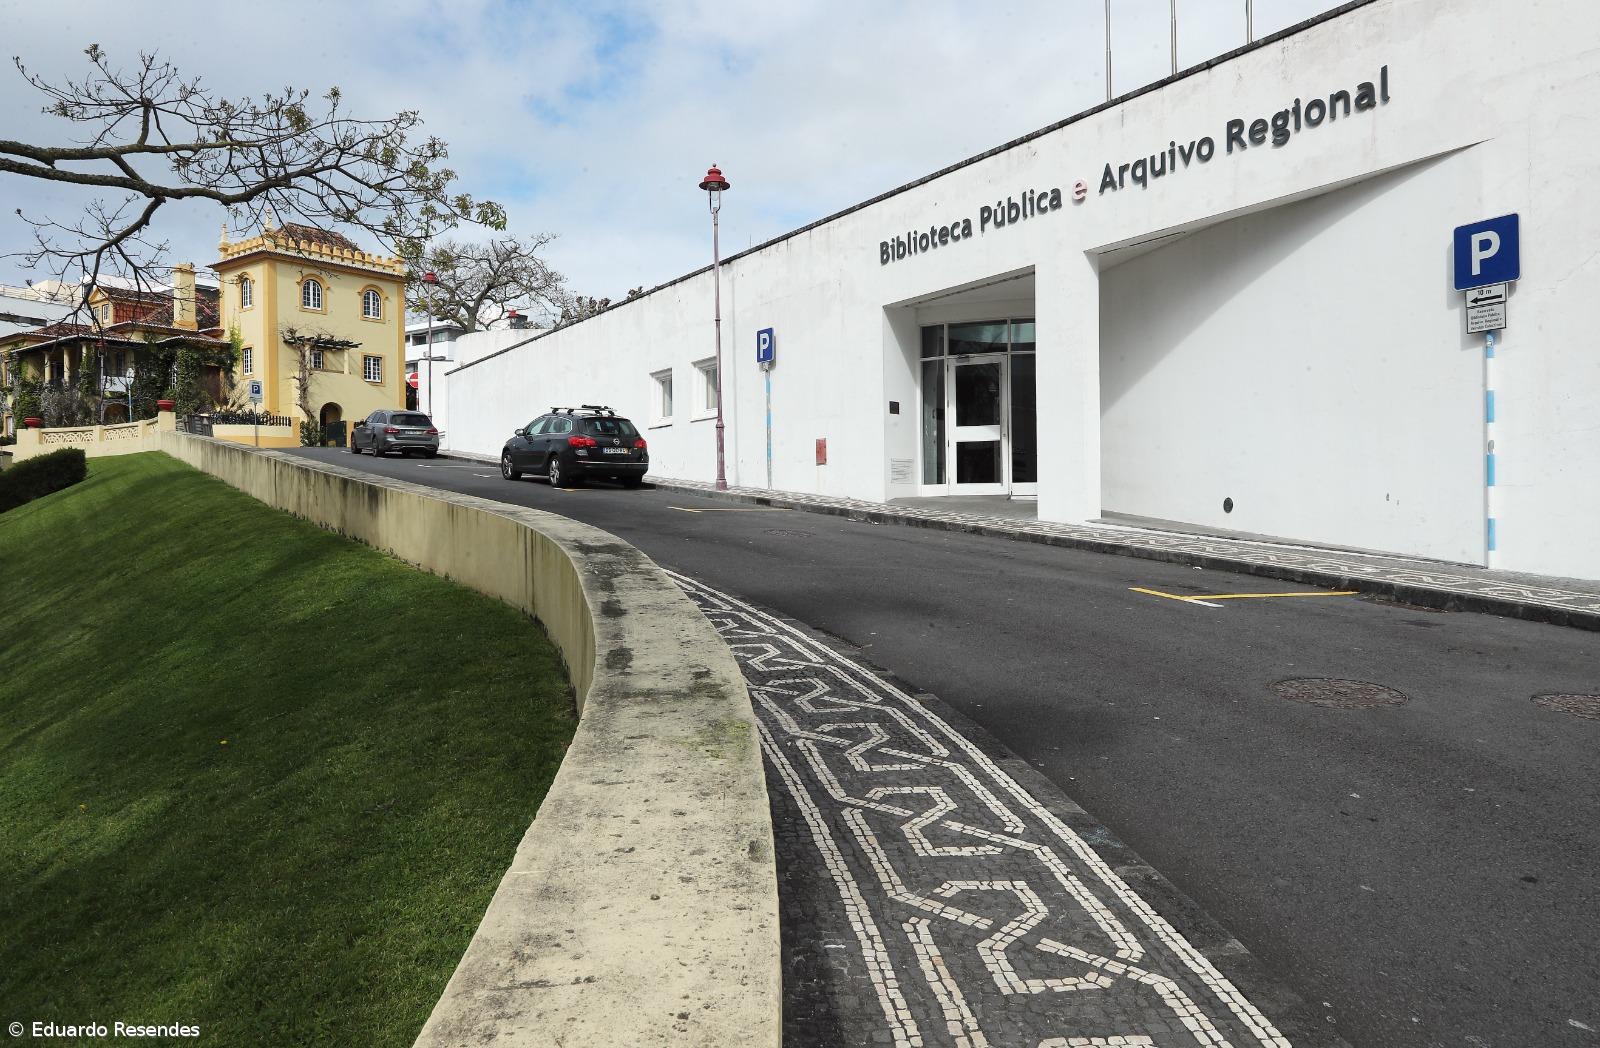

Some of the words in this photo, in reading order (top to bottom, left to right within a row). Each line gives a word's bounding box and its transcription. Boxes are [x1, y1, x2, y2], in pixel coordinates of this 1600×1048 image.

[879, 218, 973, 266] Biblioteca
[980, 188, 1063, 233] Pública
[1072, 179, 1088, 203] e
[1099, 136, 1215, 195] Arquivo
[1226, 65, 1391, 155] Regional
[1471, 230, 1500, 276] P
[760, 333, 770, 359] P
